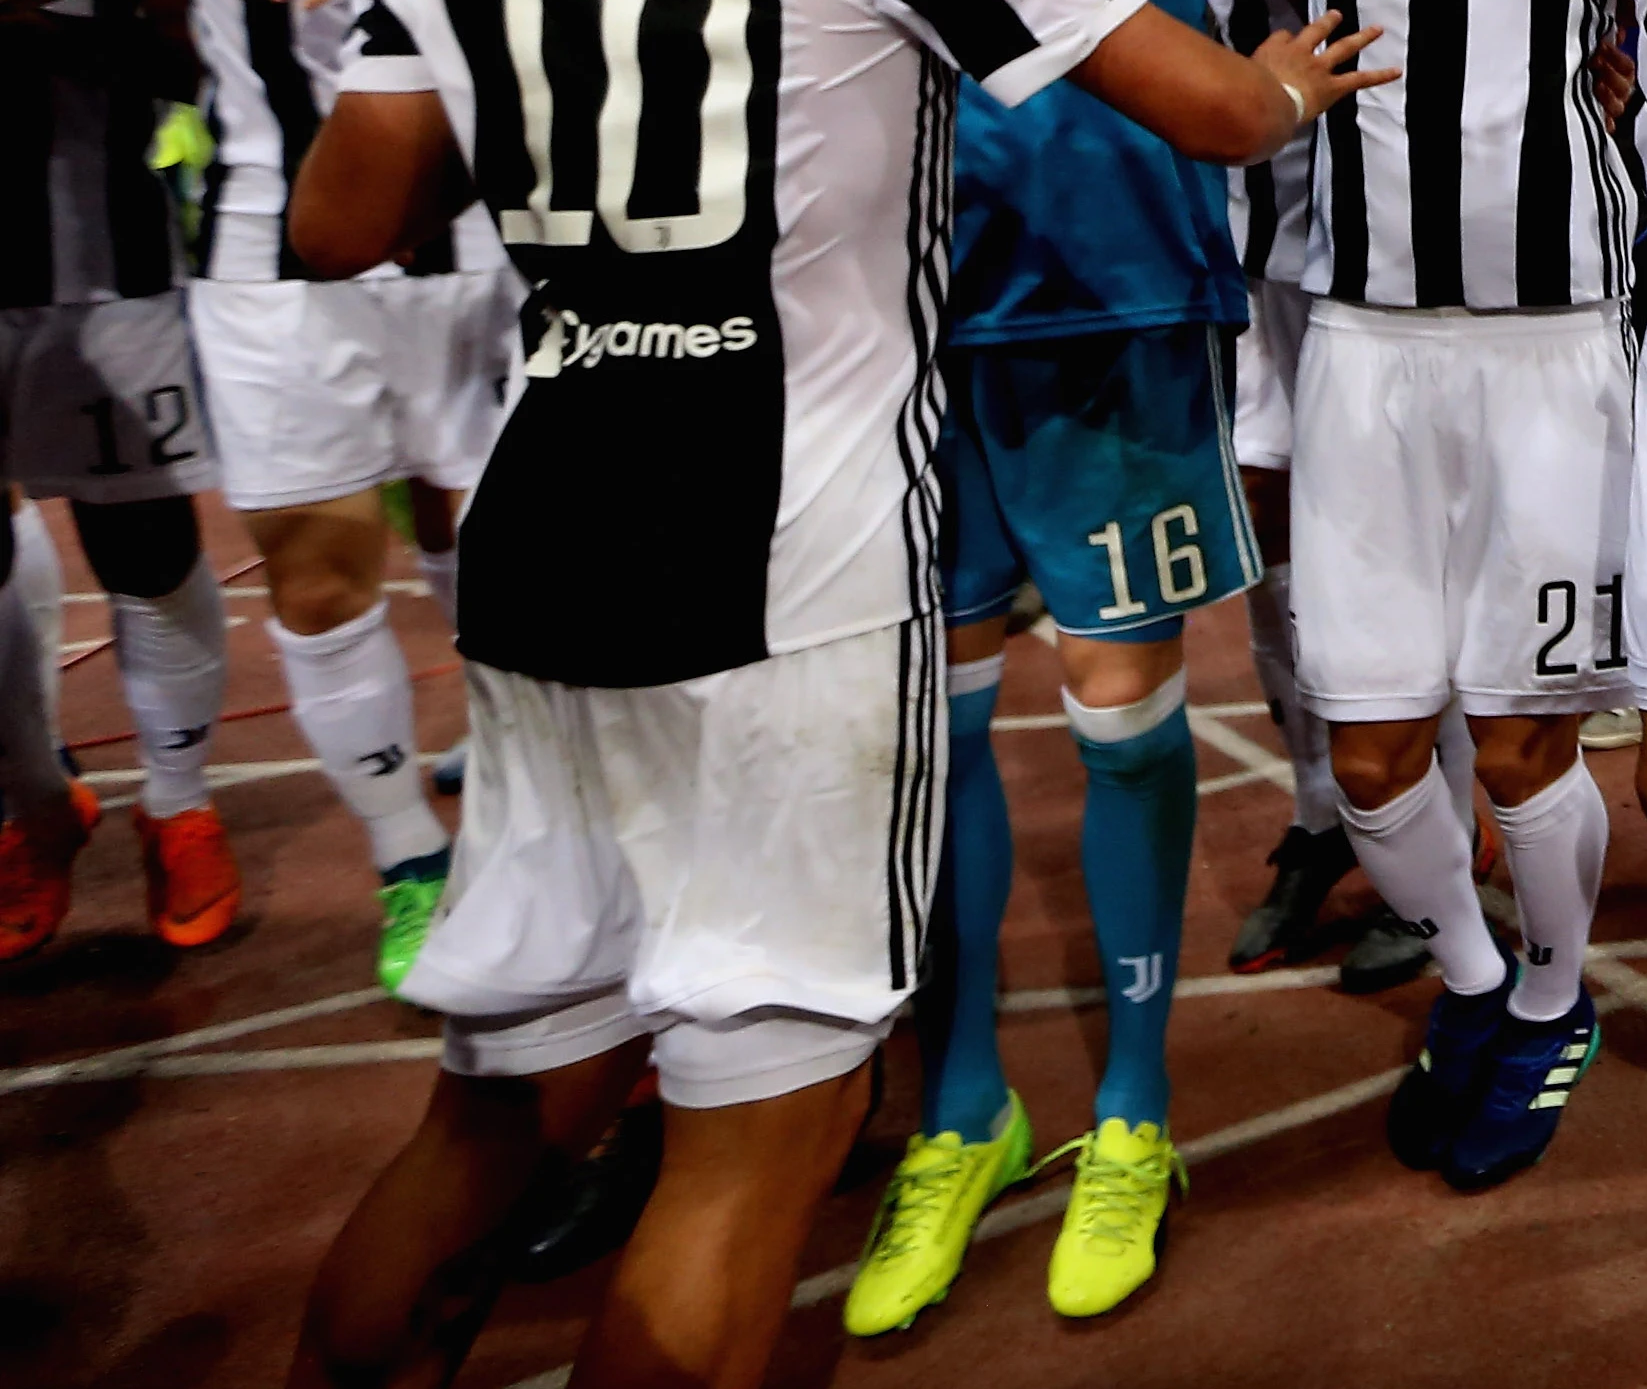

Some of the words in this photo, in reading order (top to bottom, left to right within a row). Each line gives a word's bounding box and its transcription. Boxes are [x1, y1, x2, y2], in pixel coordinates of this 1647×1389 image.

[80, 385, 197, 476] 12
[1088, 502, 1208, 621] 16
[1535, 573, 1629, 678] 21
